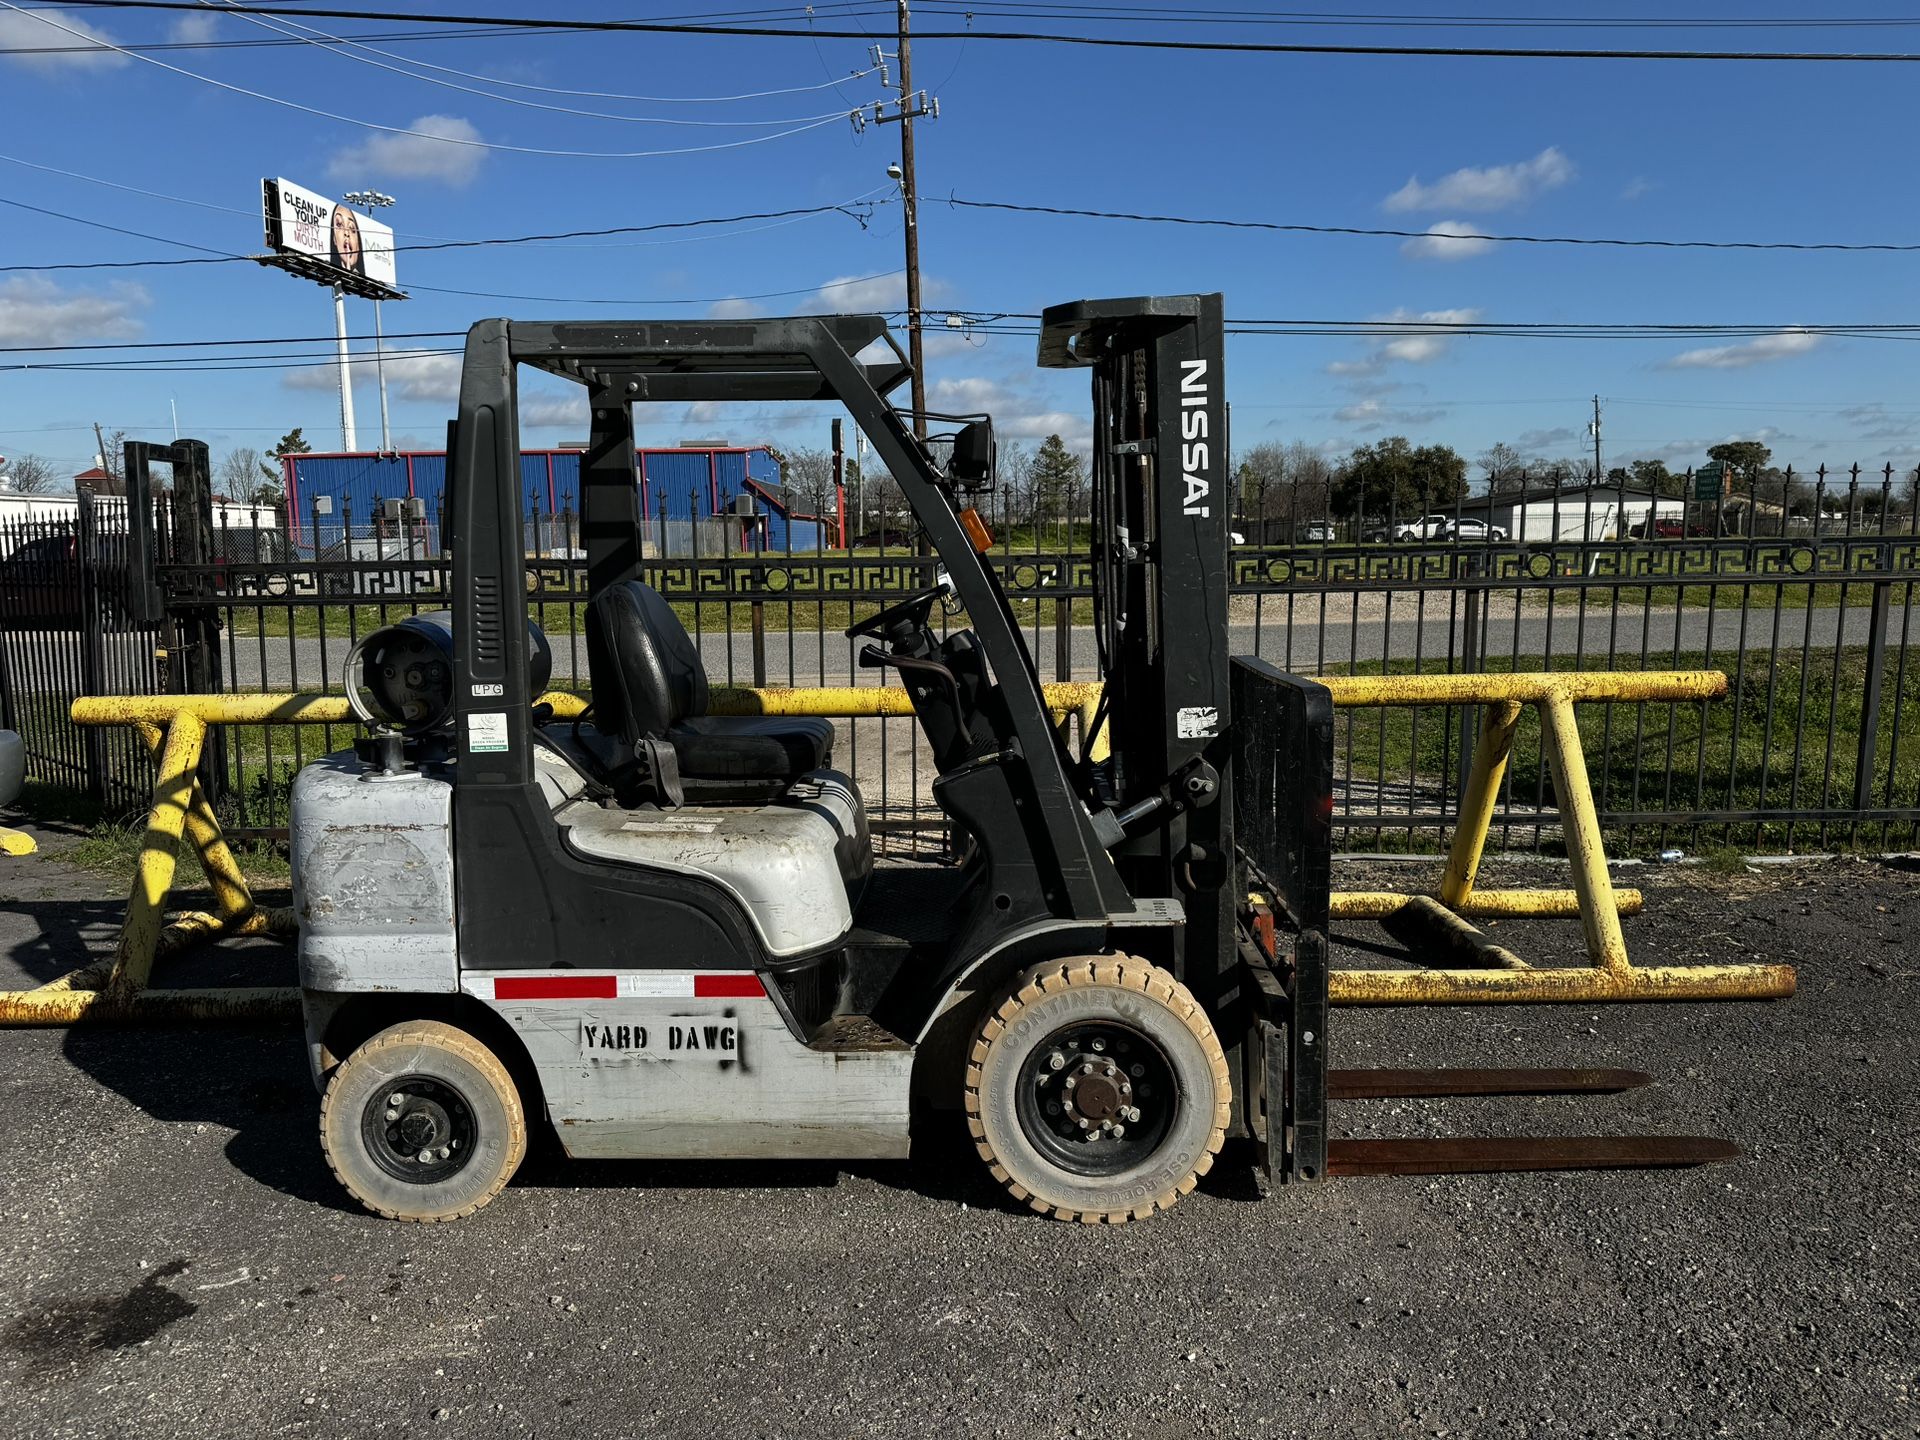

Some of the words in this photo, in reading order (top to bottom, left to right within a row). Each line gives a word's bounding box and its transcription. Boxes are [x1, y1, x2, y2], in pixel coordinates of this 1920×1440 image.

[284, 191, 314, 214] CLEAN
[315, 205, 327, 219] UP
[294, 207, 319, 228] YOUR
[295, 219, 320, 239] DIRTY
[294, 230, 324, 252] MOUTH
[474, 684, 502, 695] LPG
[584, 1025, 648, 1050] YARD
[668, 1025, 736, 1051] DAWG
[1082, 1178, 1158, 1206] ROBUST
